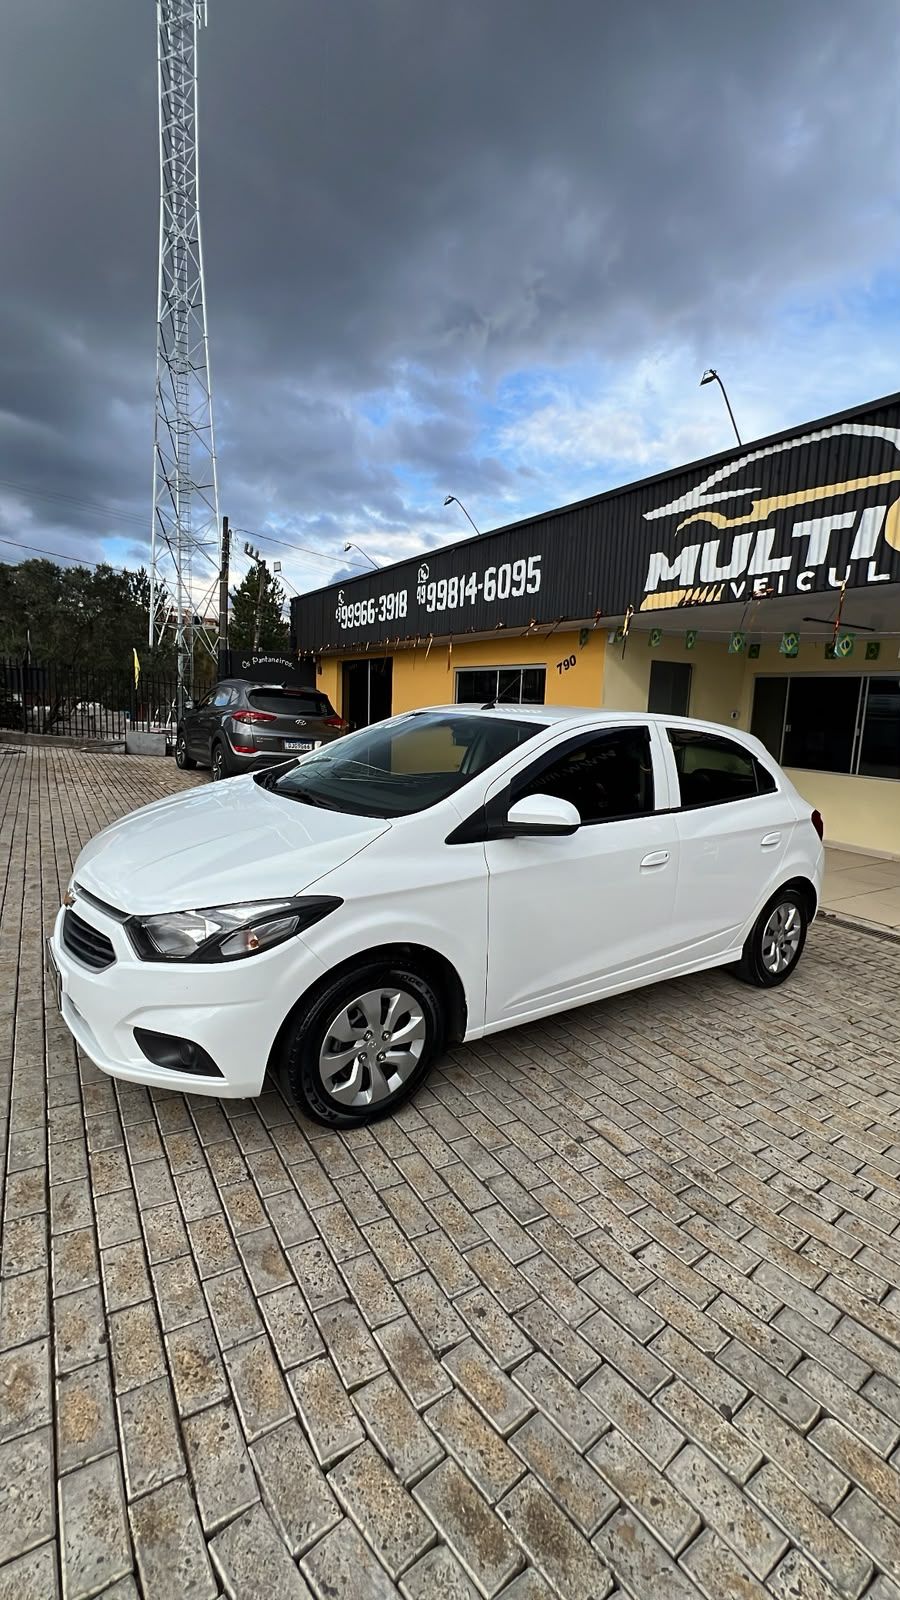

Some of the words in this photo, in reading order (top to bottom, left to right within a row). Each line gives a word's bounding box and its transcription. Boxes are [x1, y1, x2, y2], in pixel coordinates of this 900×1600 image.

[643, 496, 900, 593] MULTI
[426, 555, 542, 612] 99814-6095
[341, 589, 408, 629] 99966-3918
[556, 654, 577, 675] 790
